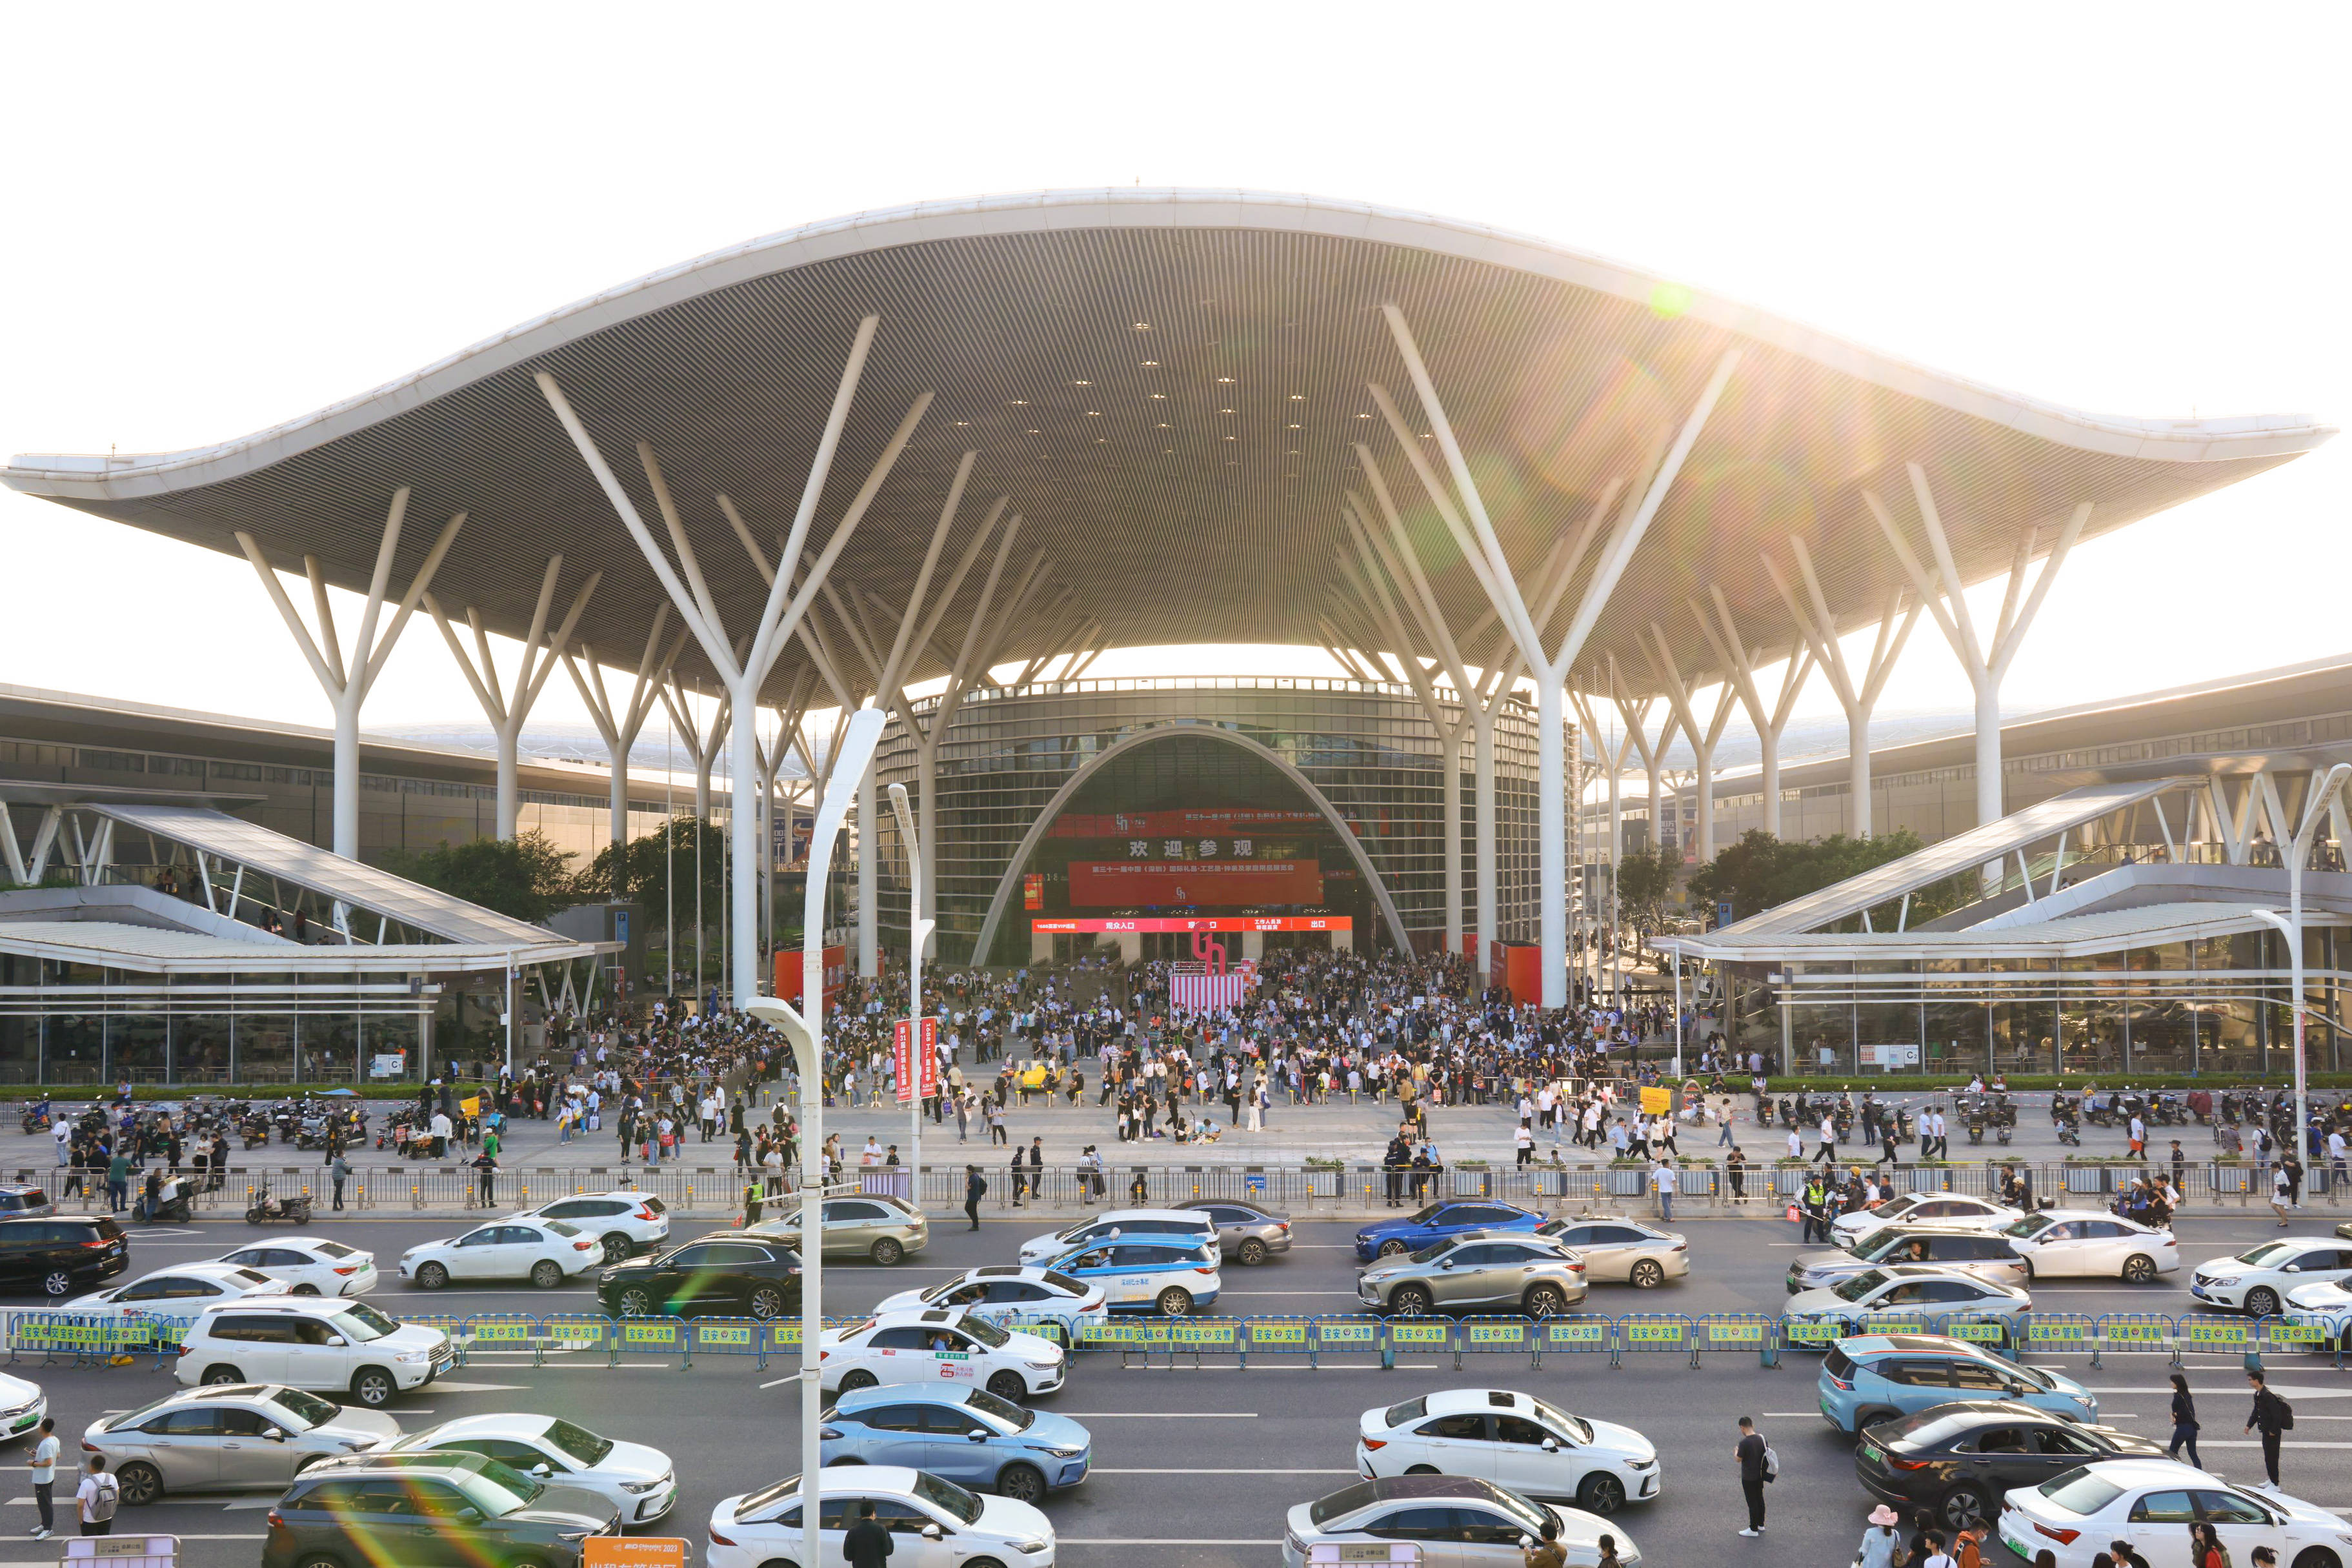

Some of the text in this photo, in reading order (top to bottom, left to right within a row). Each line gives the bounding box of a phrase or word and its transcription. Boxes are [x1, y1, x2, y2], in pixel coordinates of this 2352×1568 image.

[1130, 840, 1252, 858] 欢迎参观
[1188, 921, 1217, 930] 观口
[478, 1327, 524, 1339] 宝安交警
[554, 1327, 599, 1339] 宝安交警
[628, 1328, 673, 1340] 宝安交警
[702, 1329, 747, 1341] 宝安交警
[1085, 1328, 1133, 1340] 交通管制
[1185, 1329, 1231, 1340] 宝安交警
[1256, 1329, 1302, 1340] 宝安交警
[1323, 1328, 1371, 1340] 宝安交警
[1396, 1329, 1443, 1340] 宝安交警
[1473, 1329, 1521, 1340] 宝安交警
[1553, 1327, 1600, 1338] 宝安交警
[1632, 1327, 1678, 1338] 宝安交警
[1711, 1327, 1758, 1338] 宝安交警
[1791, 1327, 1838, 1338] 宝安交警
[1951, 1327, 2000, 1338] 宝安交警
[2031, 1327, 2082, 1338] 交通管制
[2110, 1327, 2162, 1338] 交通管制
[2193, 1328, 2244, 1340] 宝安交警
[2273, 1328, 2322, 1340] 宝安交警
